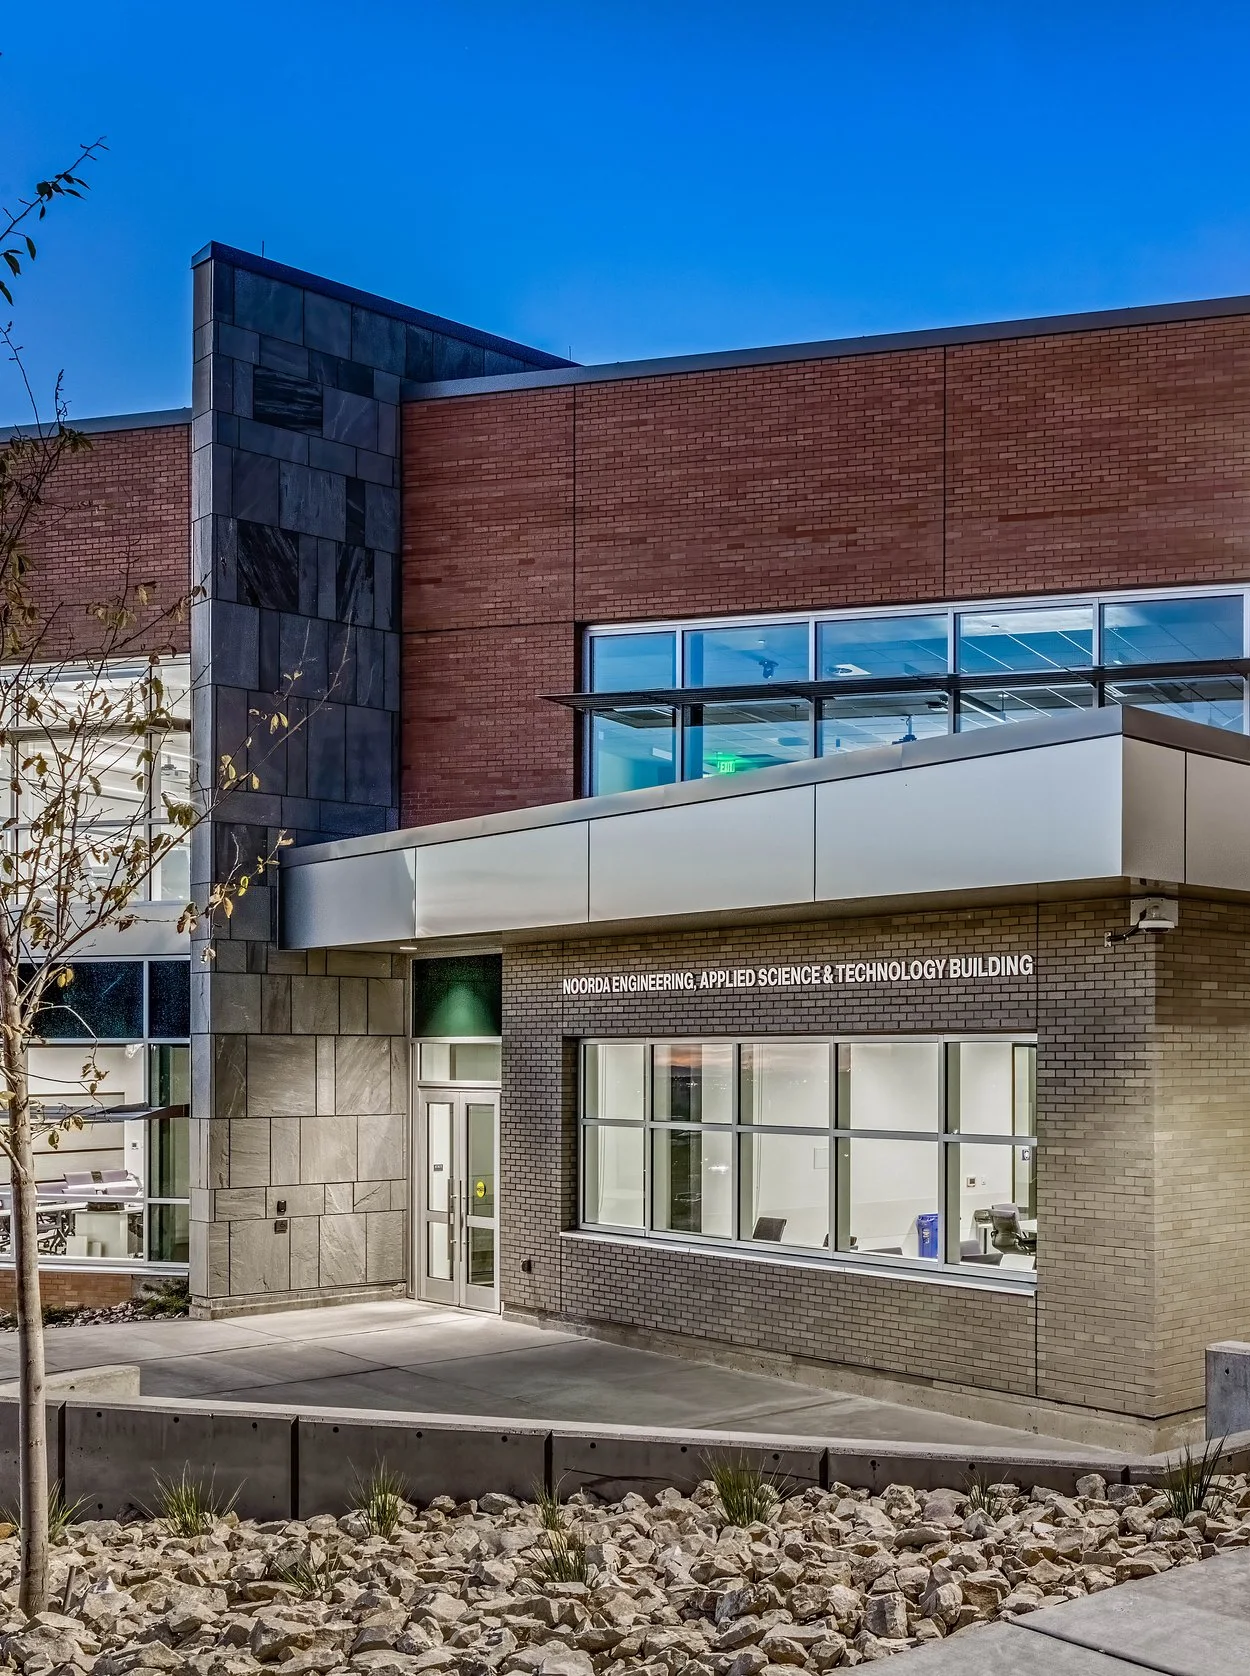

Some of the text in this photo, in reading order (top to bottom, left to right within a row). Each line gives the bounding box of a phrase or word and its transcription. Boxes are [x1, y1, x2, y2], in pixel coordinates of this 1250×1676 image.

[563, 954, 1034, 995] NOORDA ENGINEERING, APPLIED SCIENCE & TECHNOLOGY BUILDING
